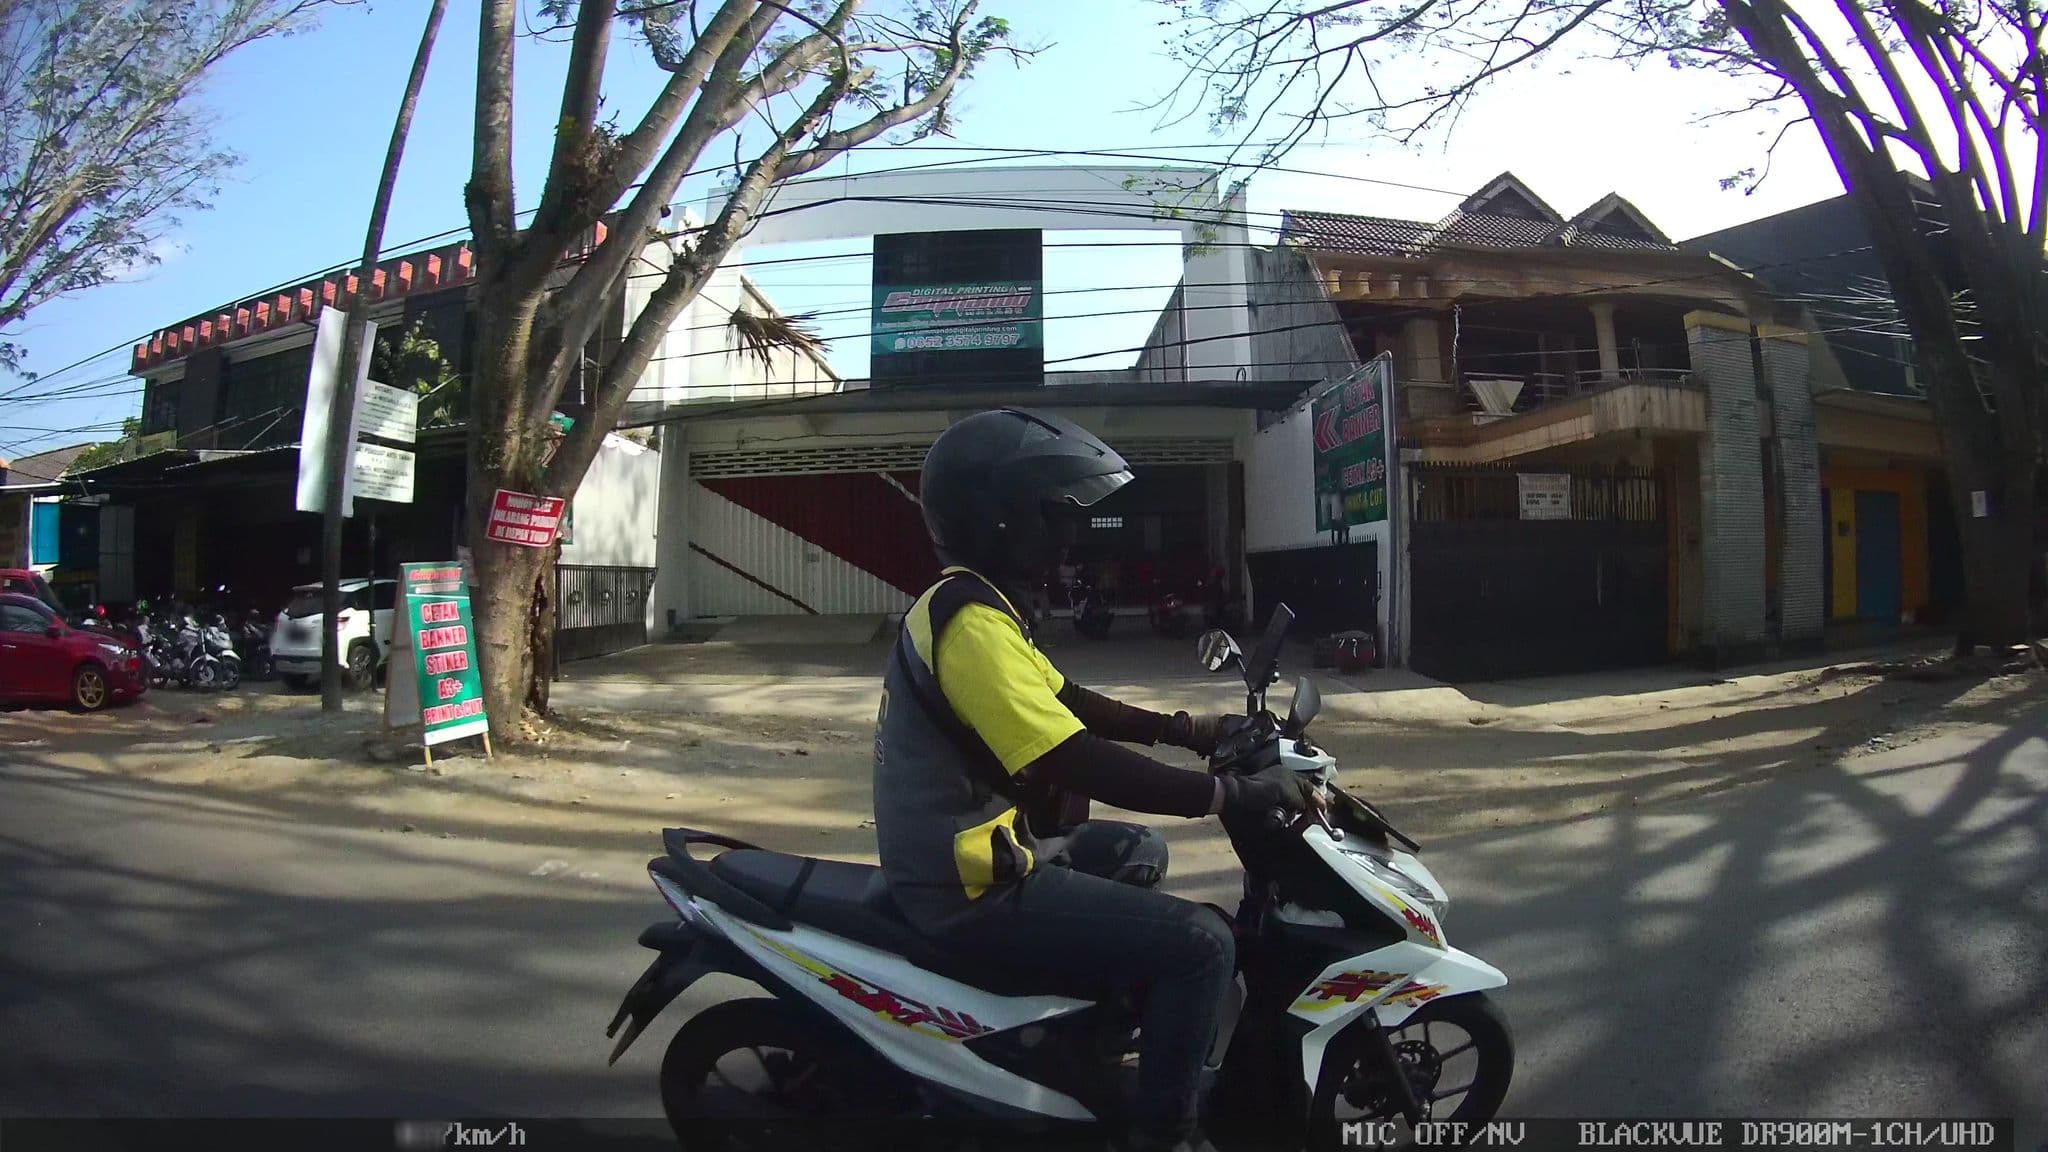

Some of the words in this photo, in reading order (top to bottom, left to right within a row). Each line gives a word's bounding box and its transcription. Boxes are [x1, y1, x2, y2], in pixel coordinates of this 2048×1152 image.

[912, 287, 953, 296] DIGITAL
[956, 286, 1009, 295] PRINTING
[945, 334, 981, 347] 3574
[984, 333, 1020, 346] 9797
[1343, 403, 1380, 442] BANNER
[422, 601, 459, 624] CETAK
[419, 625, 467, 650] BANNER
[425, 650, 468, 675] STIKER
[438, 678, 463, 699] A3+
[424, 704, 454, 725] PRINT
